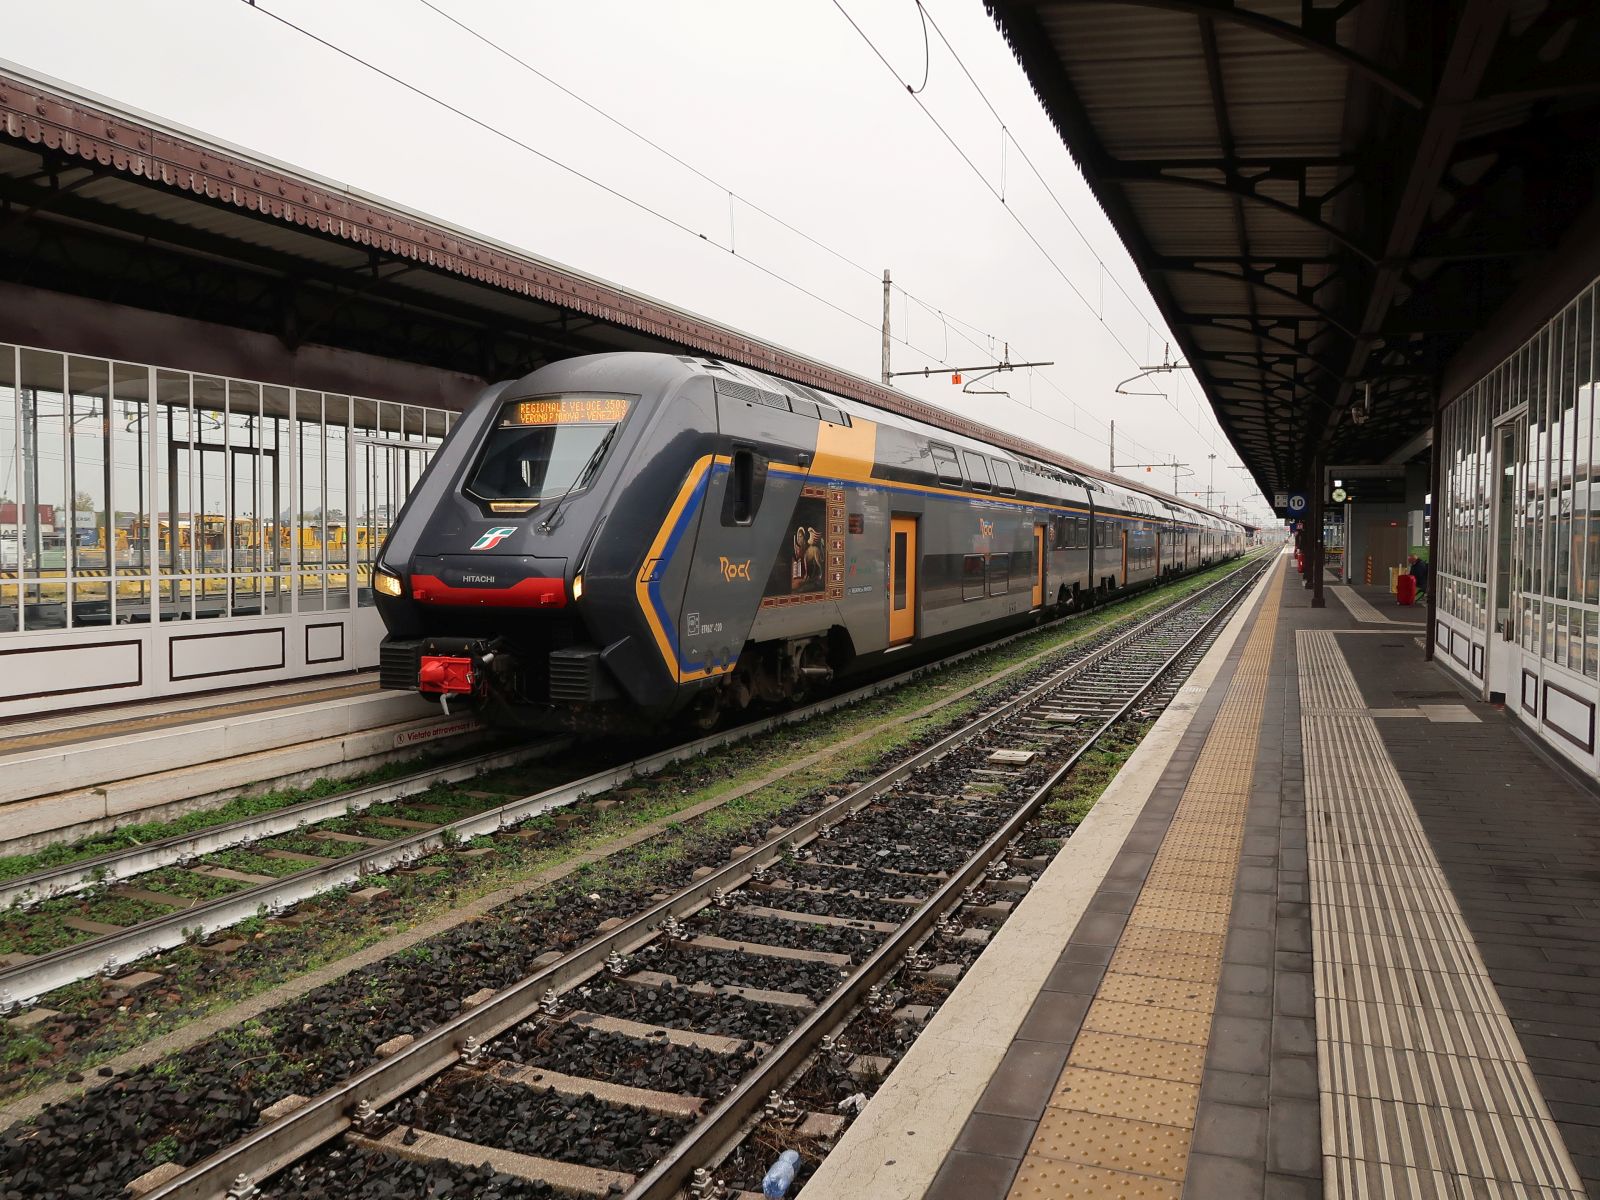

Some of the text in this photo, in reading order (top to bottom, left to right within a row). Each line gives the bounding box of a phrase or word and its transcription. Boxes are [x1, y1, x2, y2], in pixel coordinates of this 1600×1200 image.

[520, 399, 626, 414] REGIONALE VELOCE 3503
[520, 412, 548, 424] VERONA
[1291, 498, 1304, 507] 10
[719, 555, 751, 582] Rock
[462, 575, 495, 583] HITACHI
[406, 729, 431, 741] Vietato
